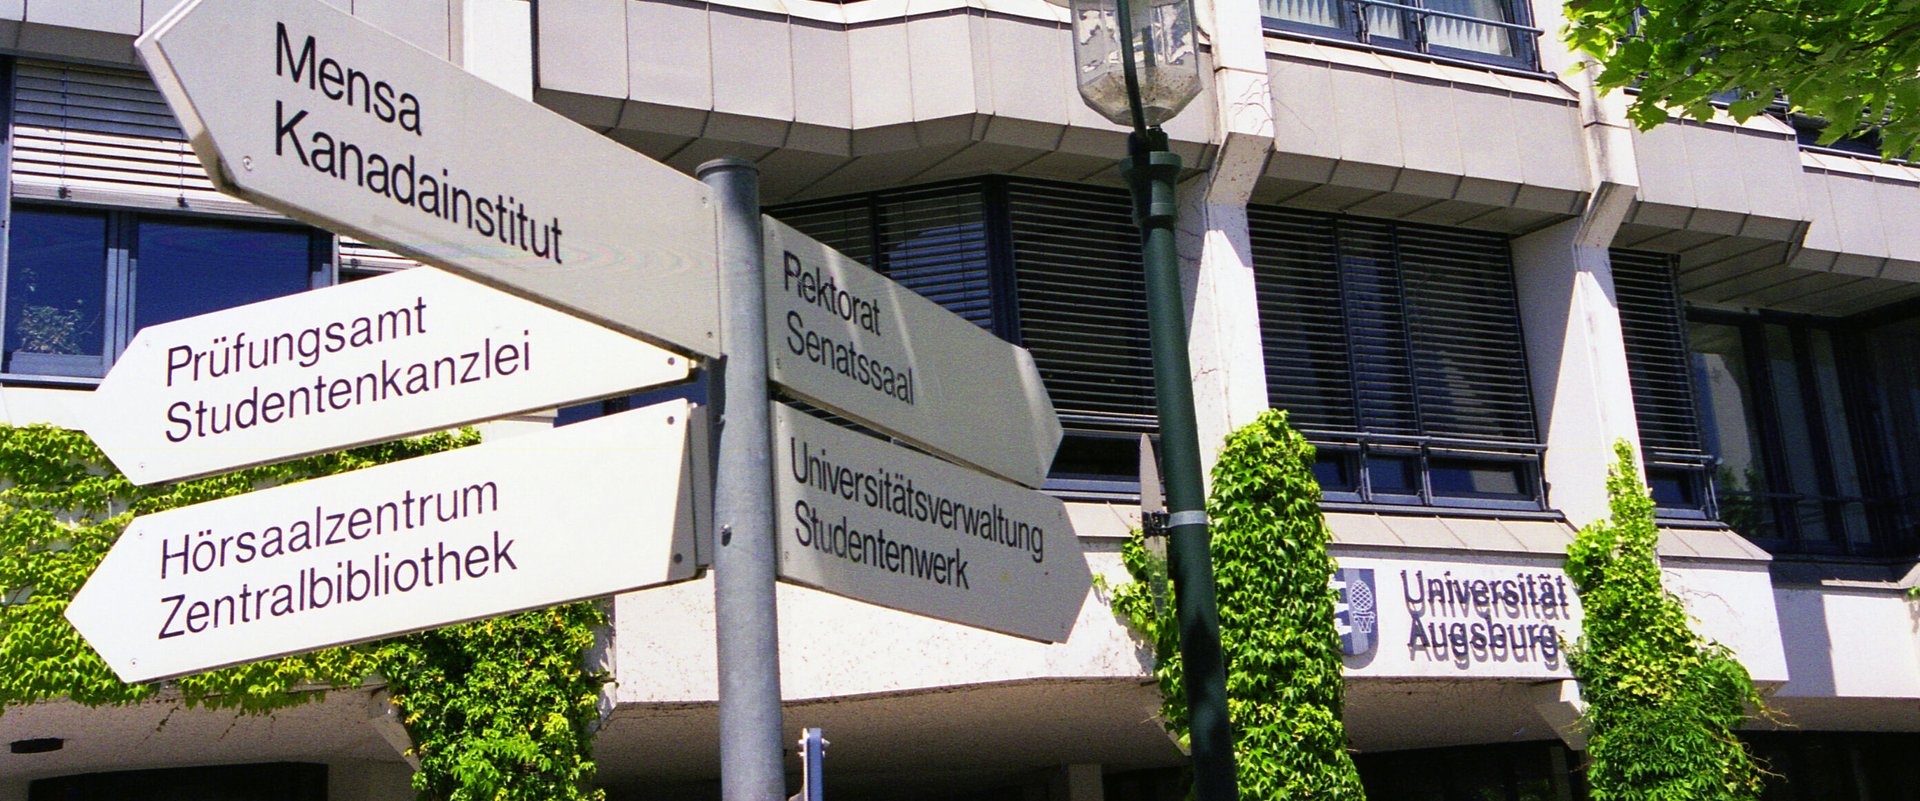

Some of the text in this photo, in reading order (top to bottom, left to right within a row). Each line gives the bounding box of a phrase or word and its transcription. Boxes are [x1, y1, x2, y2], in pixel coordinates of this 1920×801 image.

[276, 22, 422, 136] Mensa
[274, 101, 563, 264] Kanadainstitut
[783, 250, 880, 336] Rektorat
[165, 331, 531, 443] Studentenkanzlei
[166, 297, 427, 387] Prüfungsamt
[787, 310, 914, 405] Senatssaal
[160, 481, 498, 580] Hörsaalzentrum
[790, 437, 1043, 562] Universitätsverwaltung
[795, 500, 969, 589] Studentenwerk
[158, 531, 517, 639] Zentralbibliothek
[1400, 569, 1568, 608] Universität
[1407, 612, 1558, 658] Augsburg
